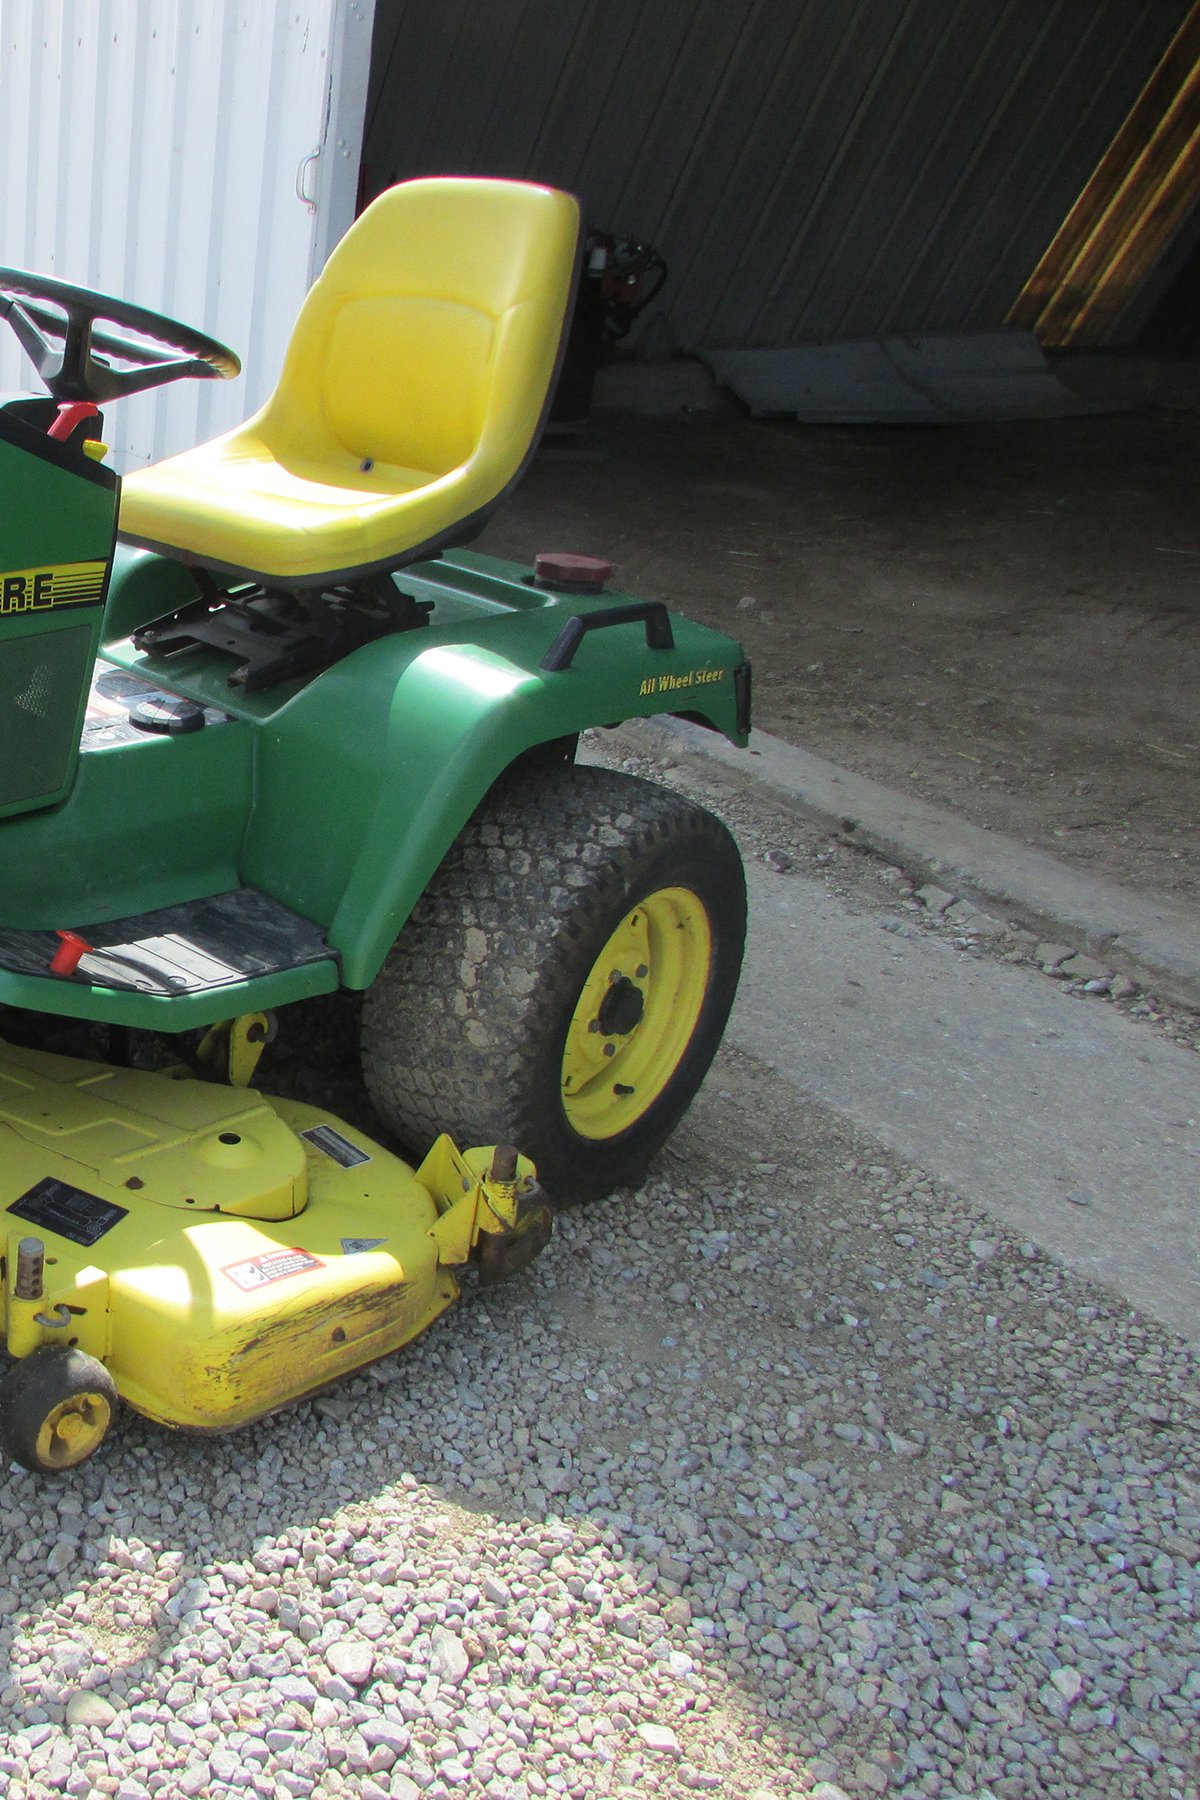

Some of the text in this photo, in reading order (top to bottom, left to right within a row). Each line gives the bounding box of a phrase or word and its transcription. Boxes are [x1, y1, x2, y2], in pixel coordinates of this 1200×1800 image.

[639, 668, 724, 696] All Wheel Steer
